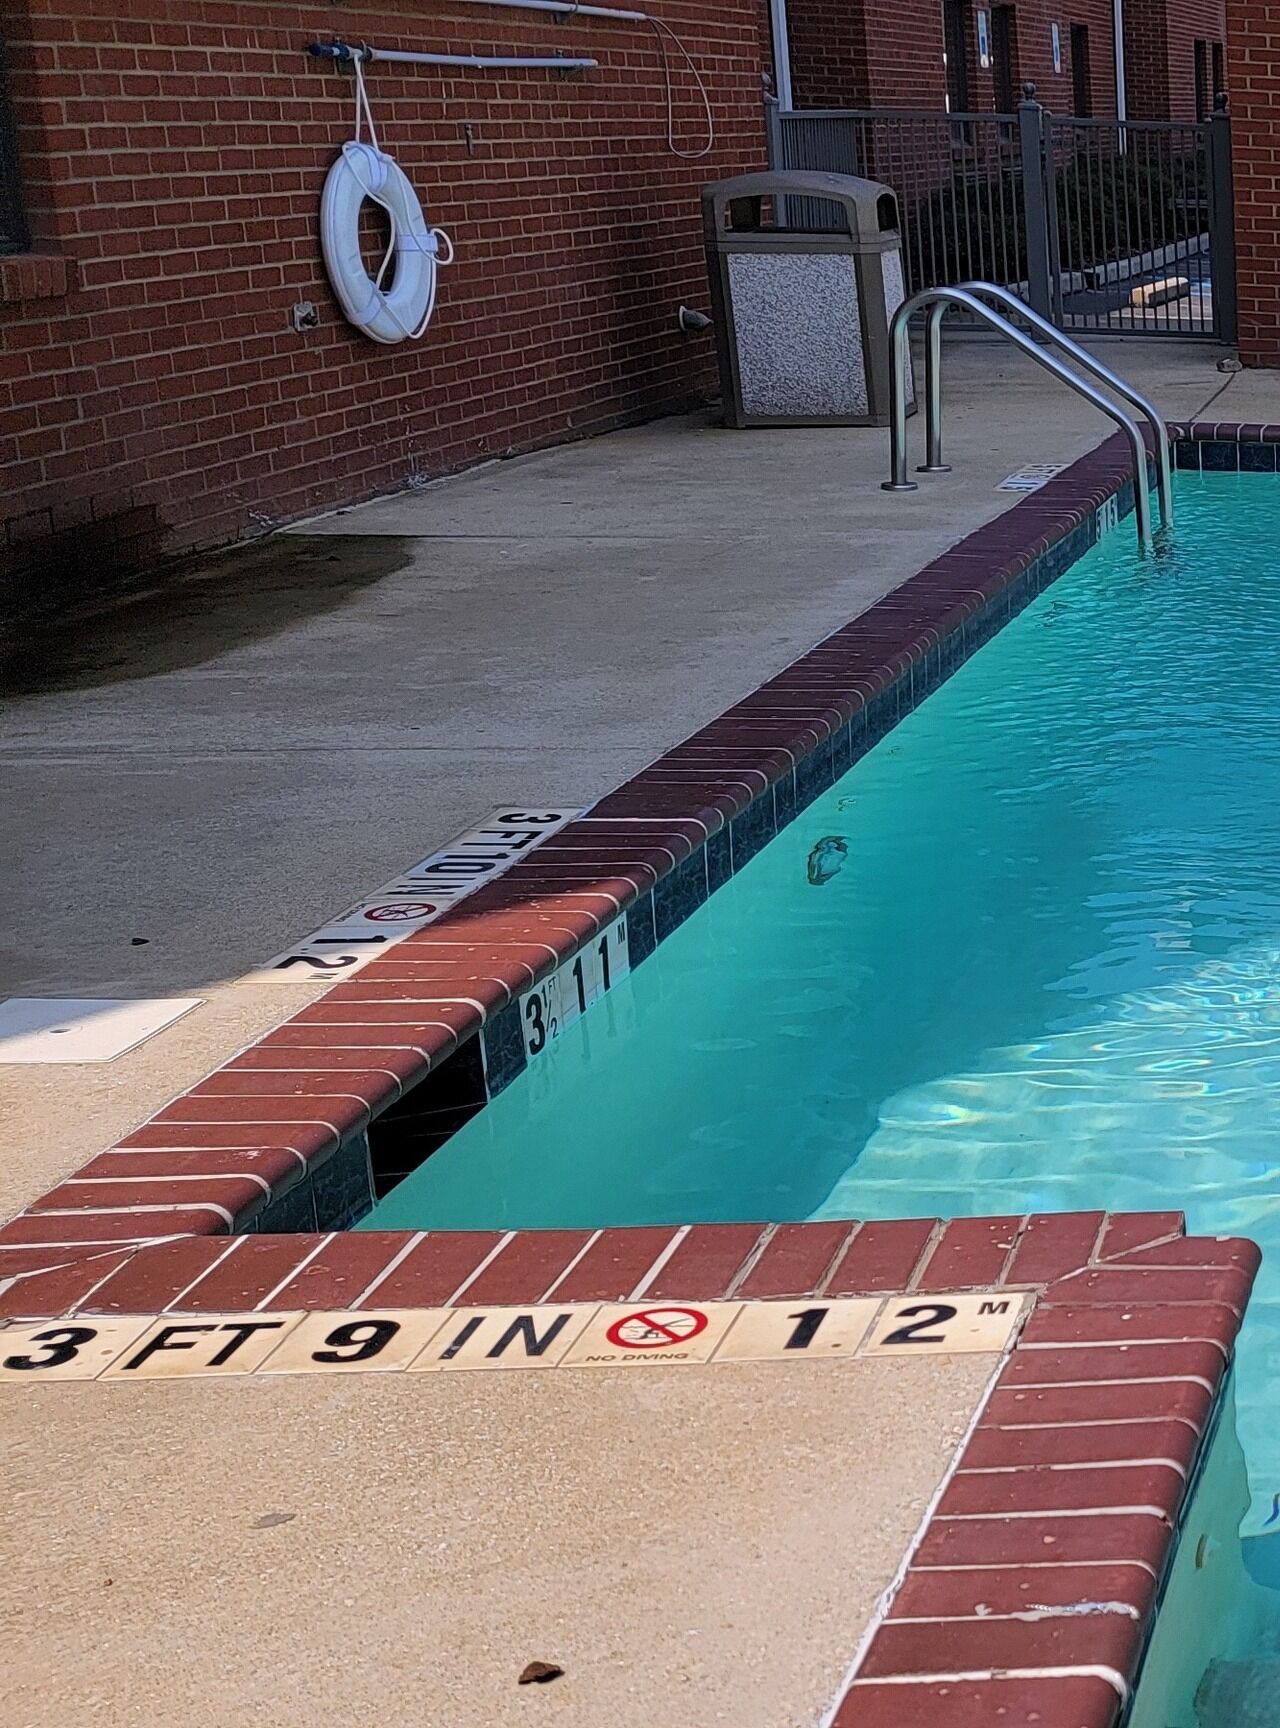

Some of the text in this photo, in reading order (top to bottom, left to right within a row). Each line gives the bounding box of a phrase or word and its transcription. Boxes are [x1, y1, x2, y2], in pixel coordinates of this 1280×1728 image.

[497, 813, 562, 824] 3
[460, 830, 545, 850] FT
[424, 852, 510, 873] 10
[386, 877, 476, 895] IN
[526, 993, 546, 1055] 3
[617, 921, 626, 944] M
[3, 1326, 98, 1371] 3
[121, 1320, 287, 1371] FT
[312, 1319, 401, 1363] 9
[437, 1313, 574, 1361] IN
[977, 1301, 1010, 1315] M
[621, 1353, 689, 1361] DIVING
